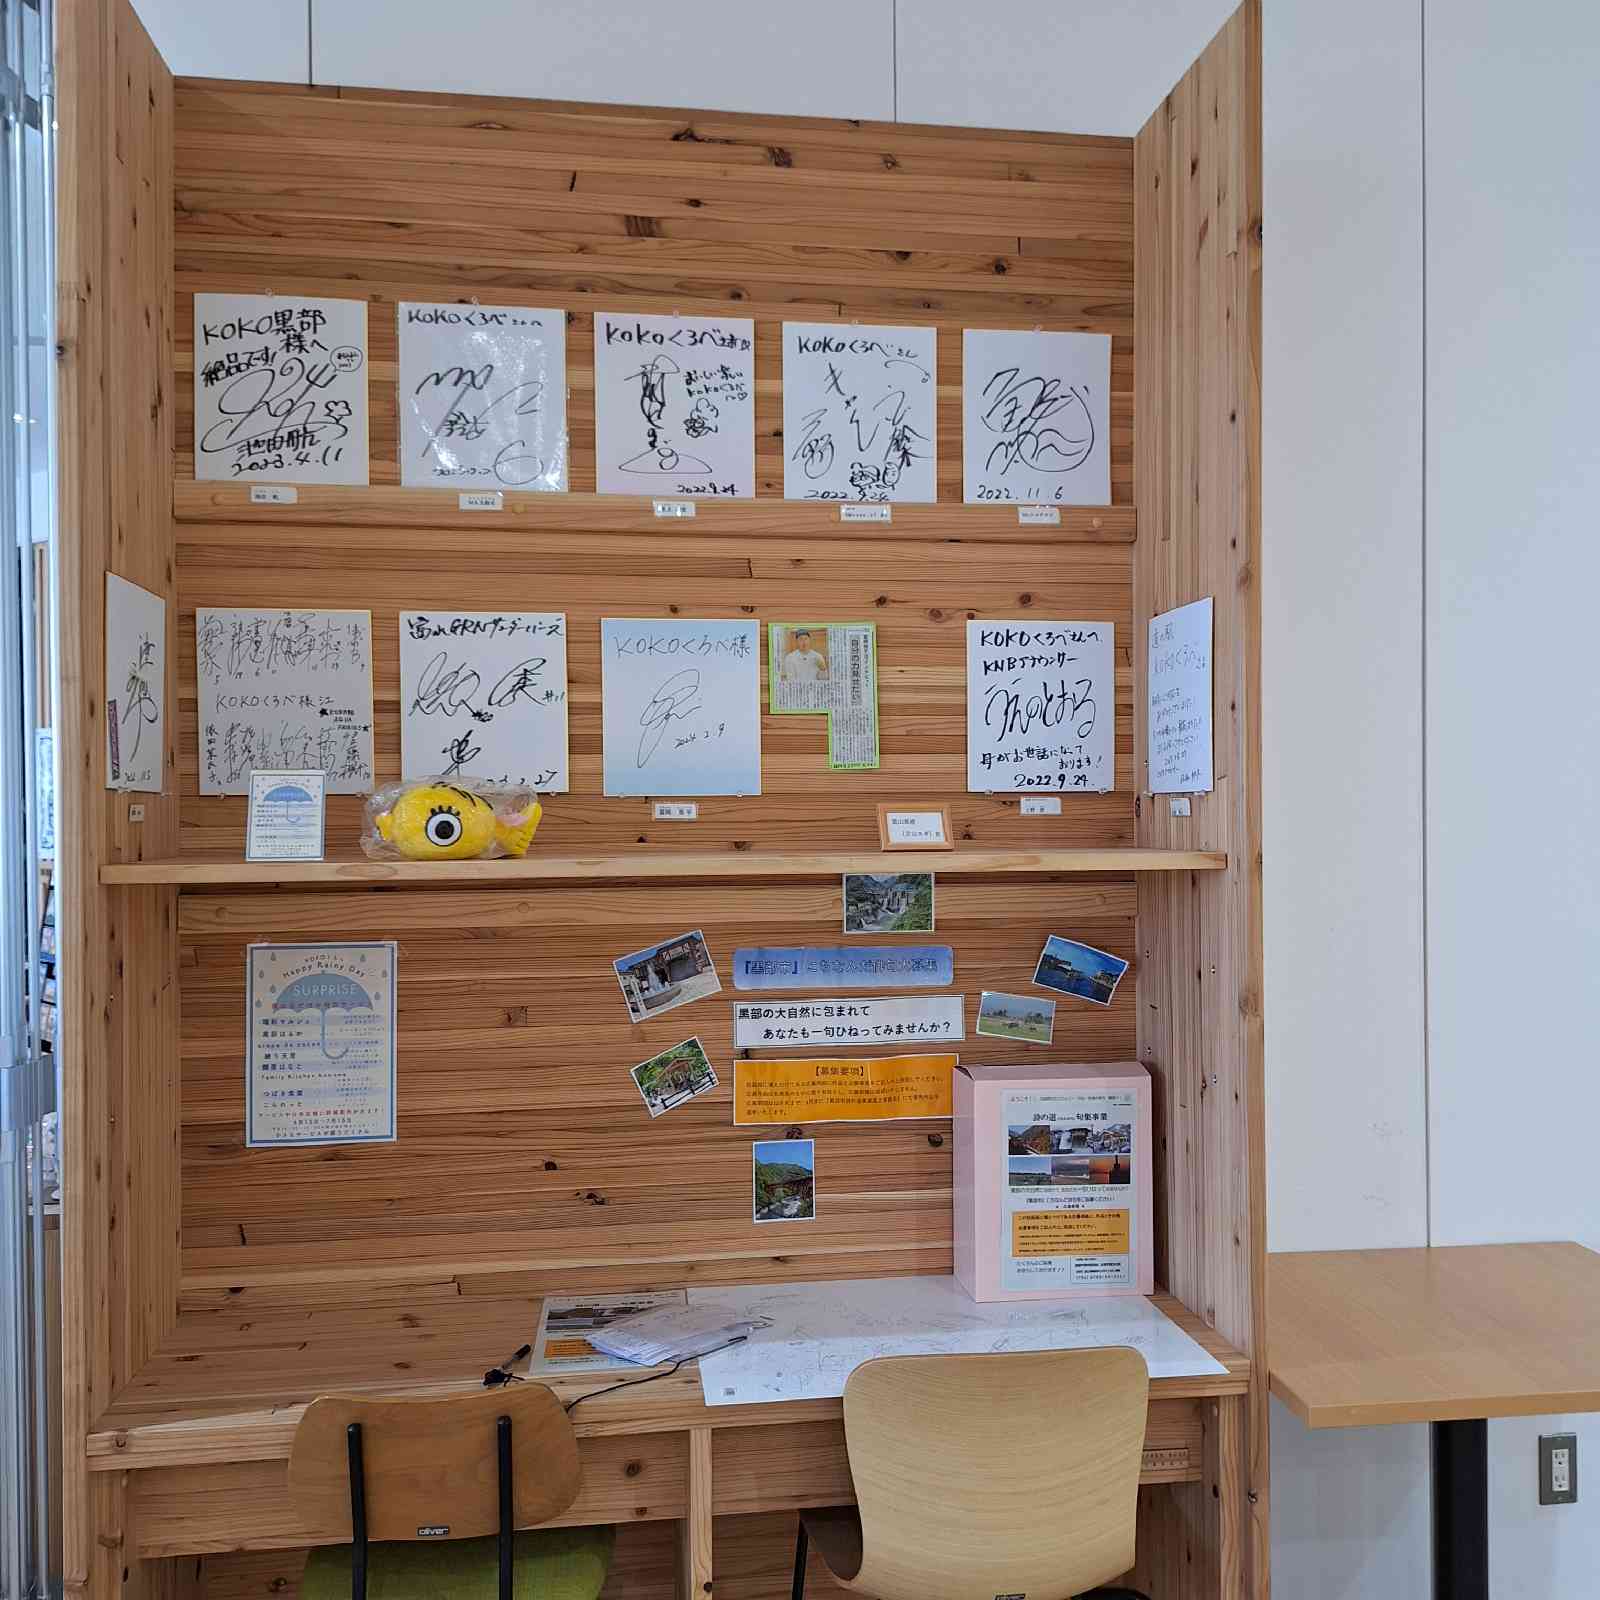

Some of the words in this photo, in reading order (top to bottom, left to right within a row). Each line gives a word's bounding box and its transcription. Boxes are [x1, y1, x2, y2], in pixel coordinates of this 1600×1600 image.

[282, 963, 313, 979] Happy
[317, 960, 345, 971] Rainy
[294, 983, 359, 997] SURPRISE
[738, 1005, 871, 1020] 黒部の大自然に包まれて
